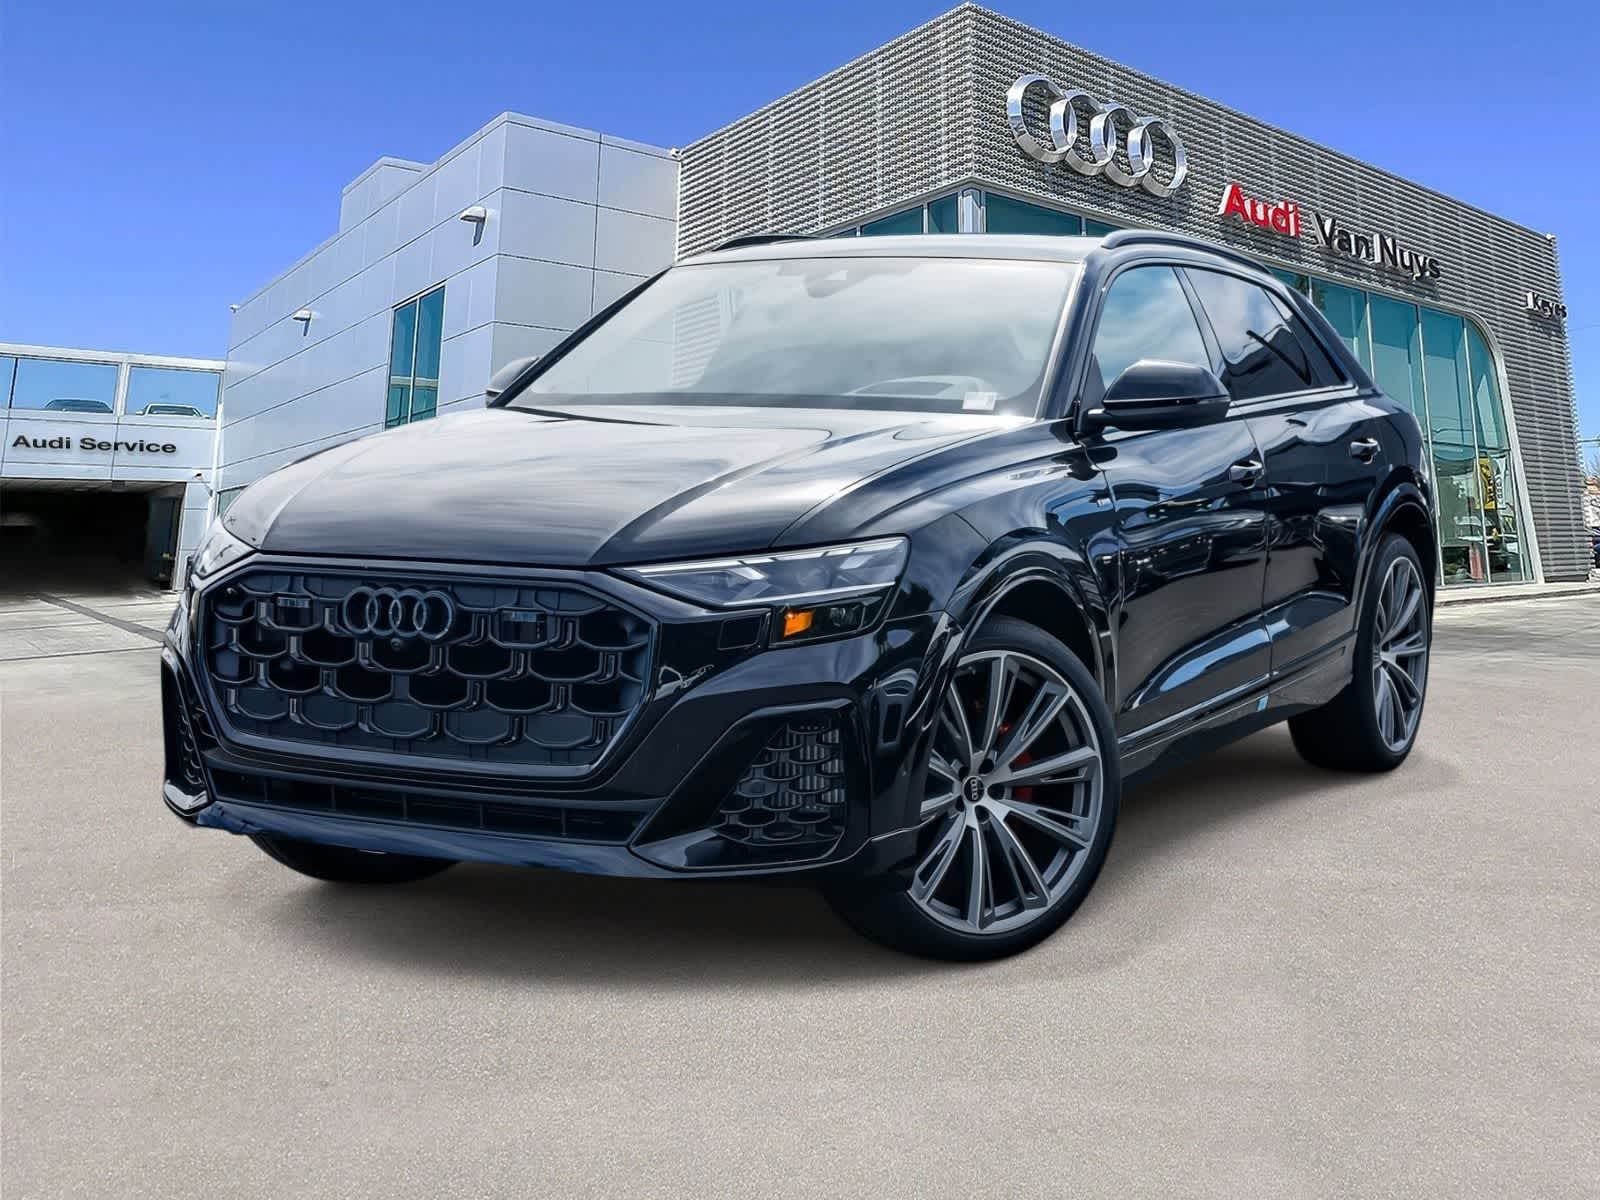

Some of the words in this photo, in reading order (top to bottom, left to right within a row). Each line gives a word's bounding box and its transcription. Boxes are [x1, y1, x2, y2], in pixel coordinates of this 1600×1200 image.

[1218, 183, 1301, 238] Audi
[1311, 212, 1371, 257] Van
[1373, 233, 1440, 280] Nuys
[1526, 291, 1567, 318] Keyes
[12, 435, 71, 449] Audi
[79, 437, 177, 453] Service
